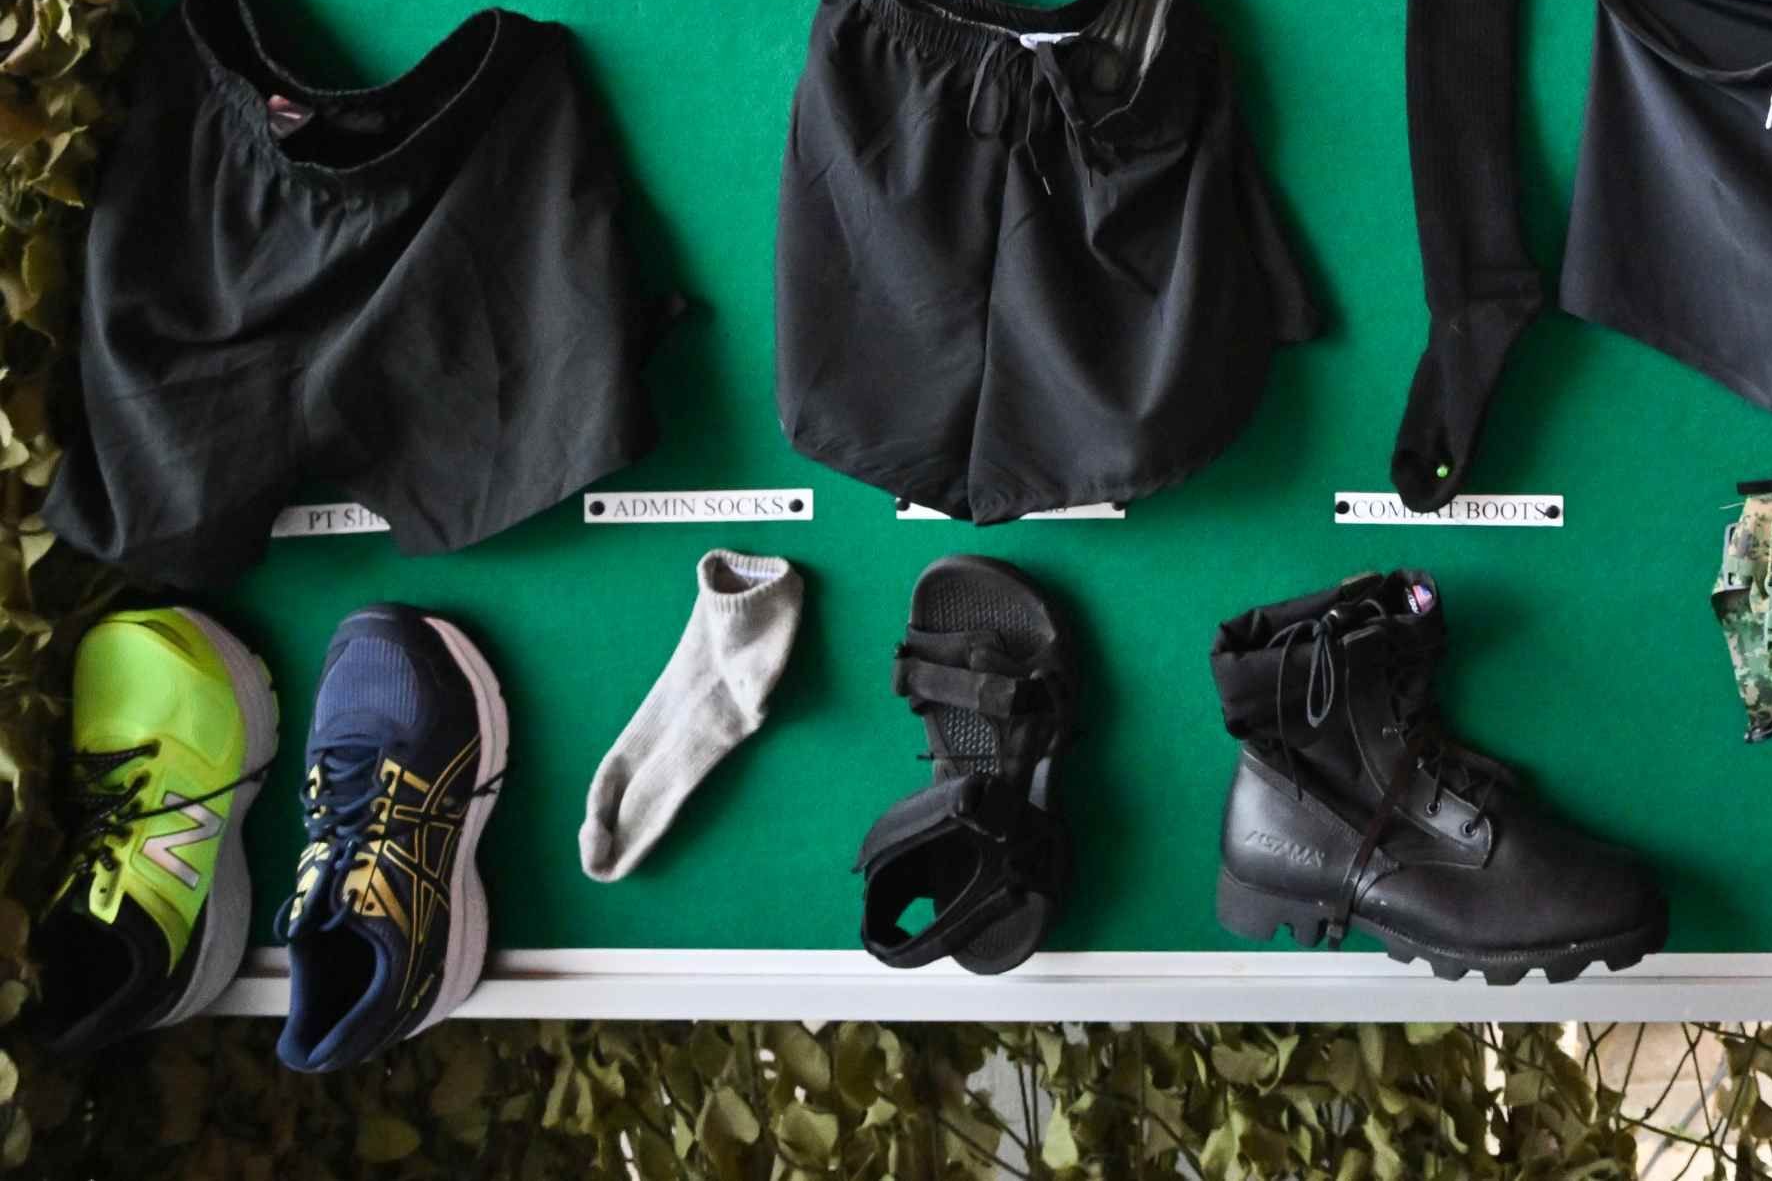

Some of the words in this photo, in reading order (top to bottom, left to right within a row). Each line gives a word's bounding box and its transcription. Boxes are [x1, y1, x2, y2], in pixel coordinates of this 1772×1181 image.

[613, 497, 697, 518] ADMIN
[704, 496, 785, 517] SOCKS
[1465, 501, 1549, 521] BOOTS
[308, 509, 336, 530] PT
